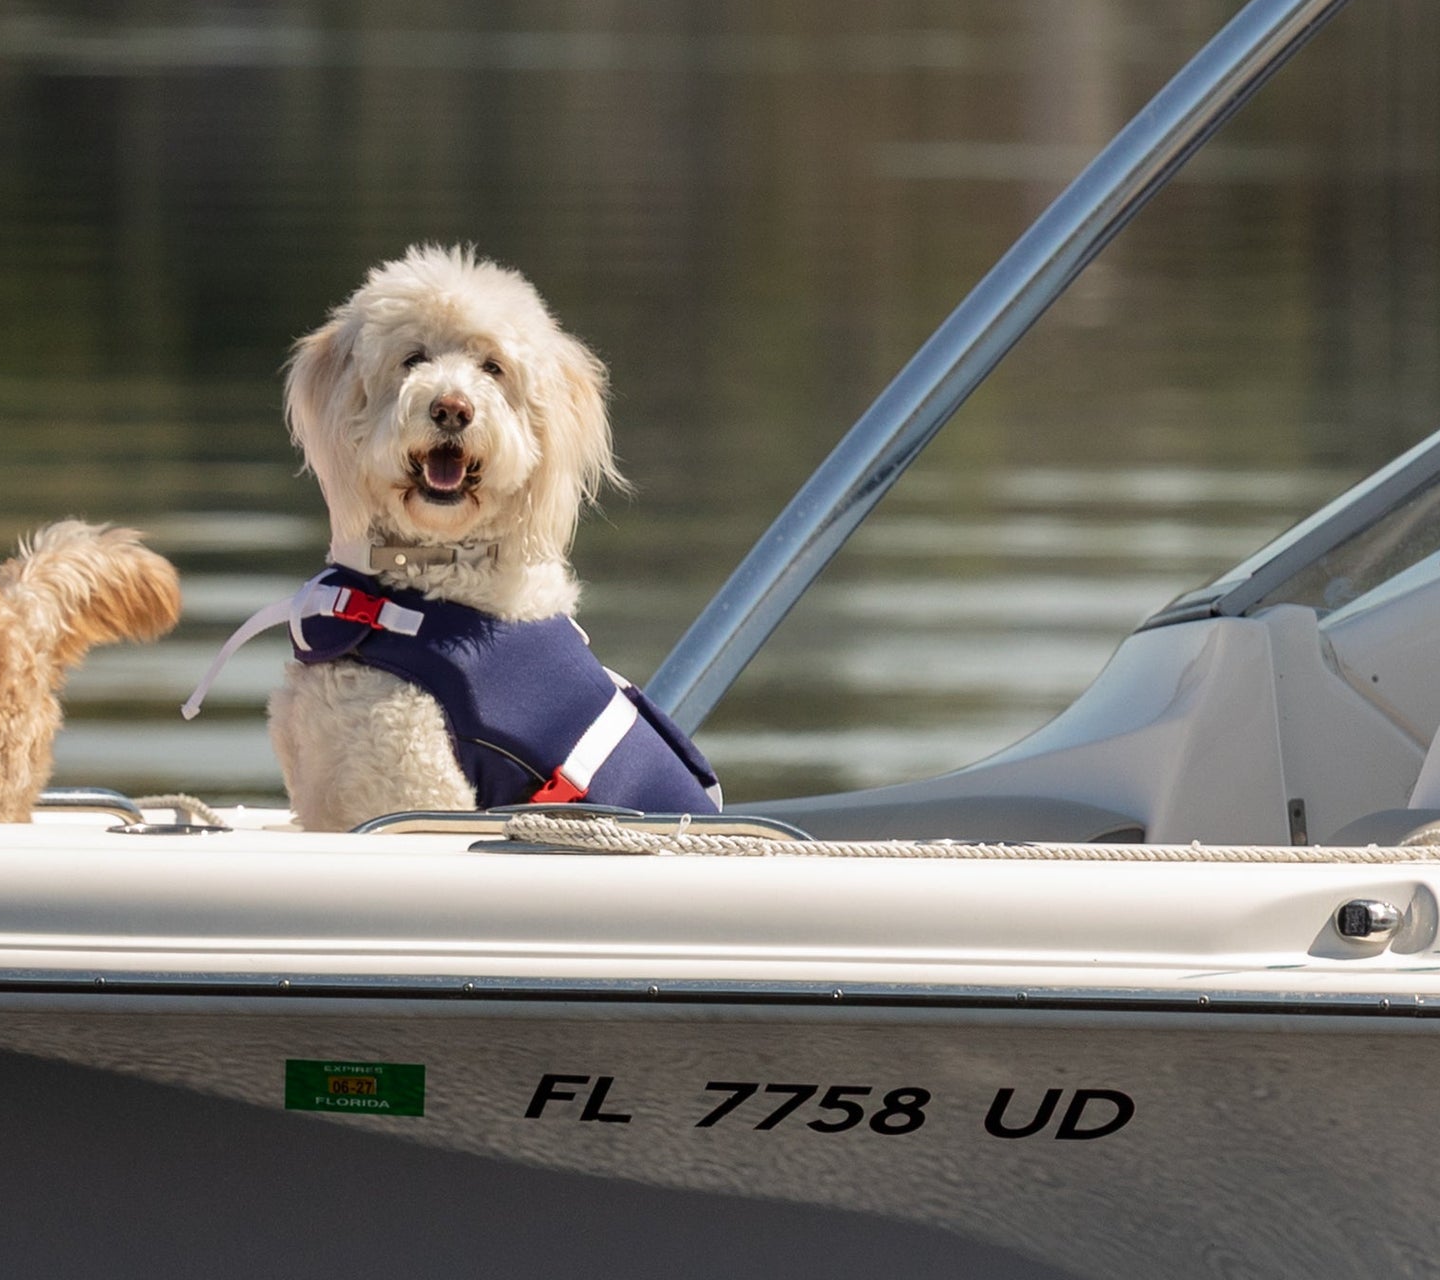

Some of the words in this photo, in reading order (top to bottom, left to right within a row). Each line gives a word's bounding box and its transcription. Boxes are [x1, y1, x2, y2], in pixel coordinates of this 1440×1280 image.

[324, 1065, 383, 1074] EXPIRES
[333, 1080, 373, 1094] 06-27
[315, 1096, 391, 1108] FLORIDA
[524, 1073, 632, 1123] FL
[694, 1081, 931, 1135] 7758
[984, 1088, 1135, 1140] UD
